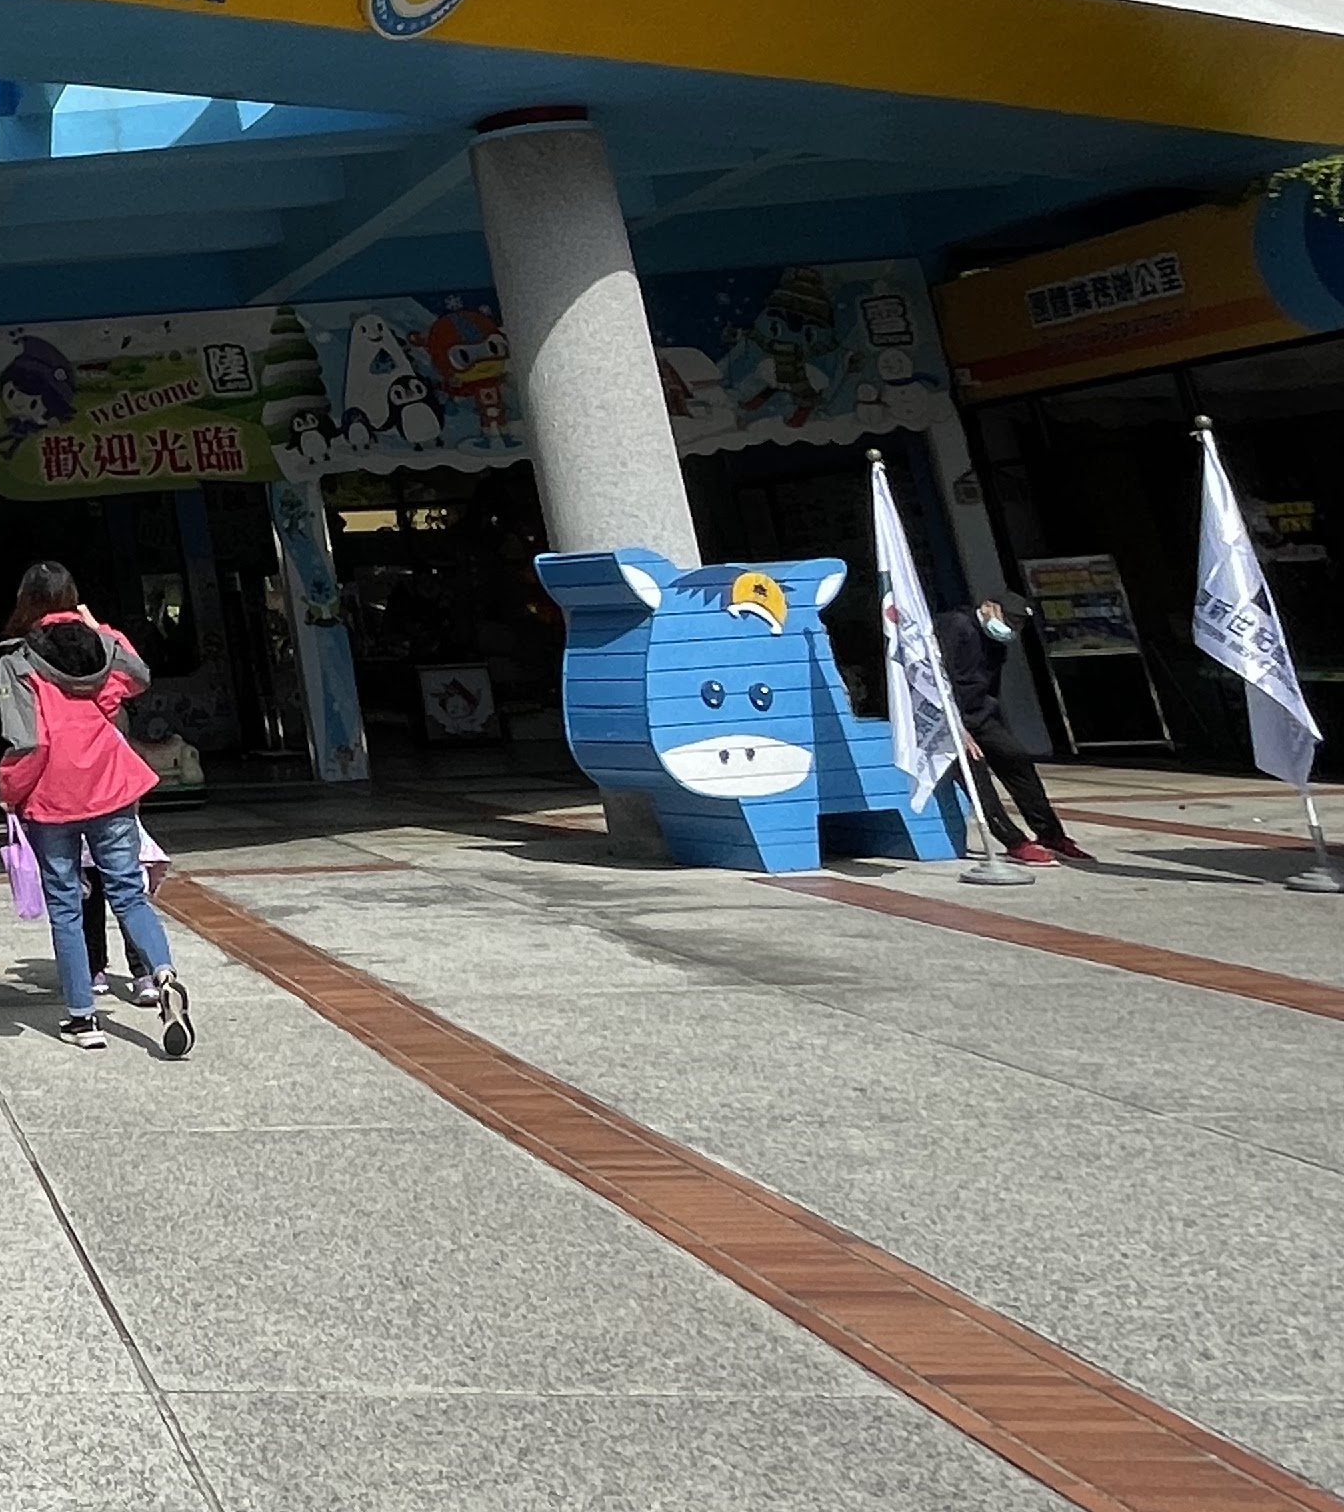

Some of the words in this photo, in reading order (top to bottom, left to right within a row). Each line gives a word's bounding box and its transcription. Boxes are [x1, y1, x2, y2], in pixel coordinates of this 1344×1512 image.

[89, 378, 200, 425] welcome
[41, 425, 245, 482] 歡迎光臨
